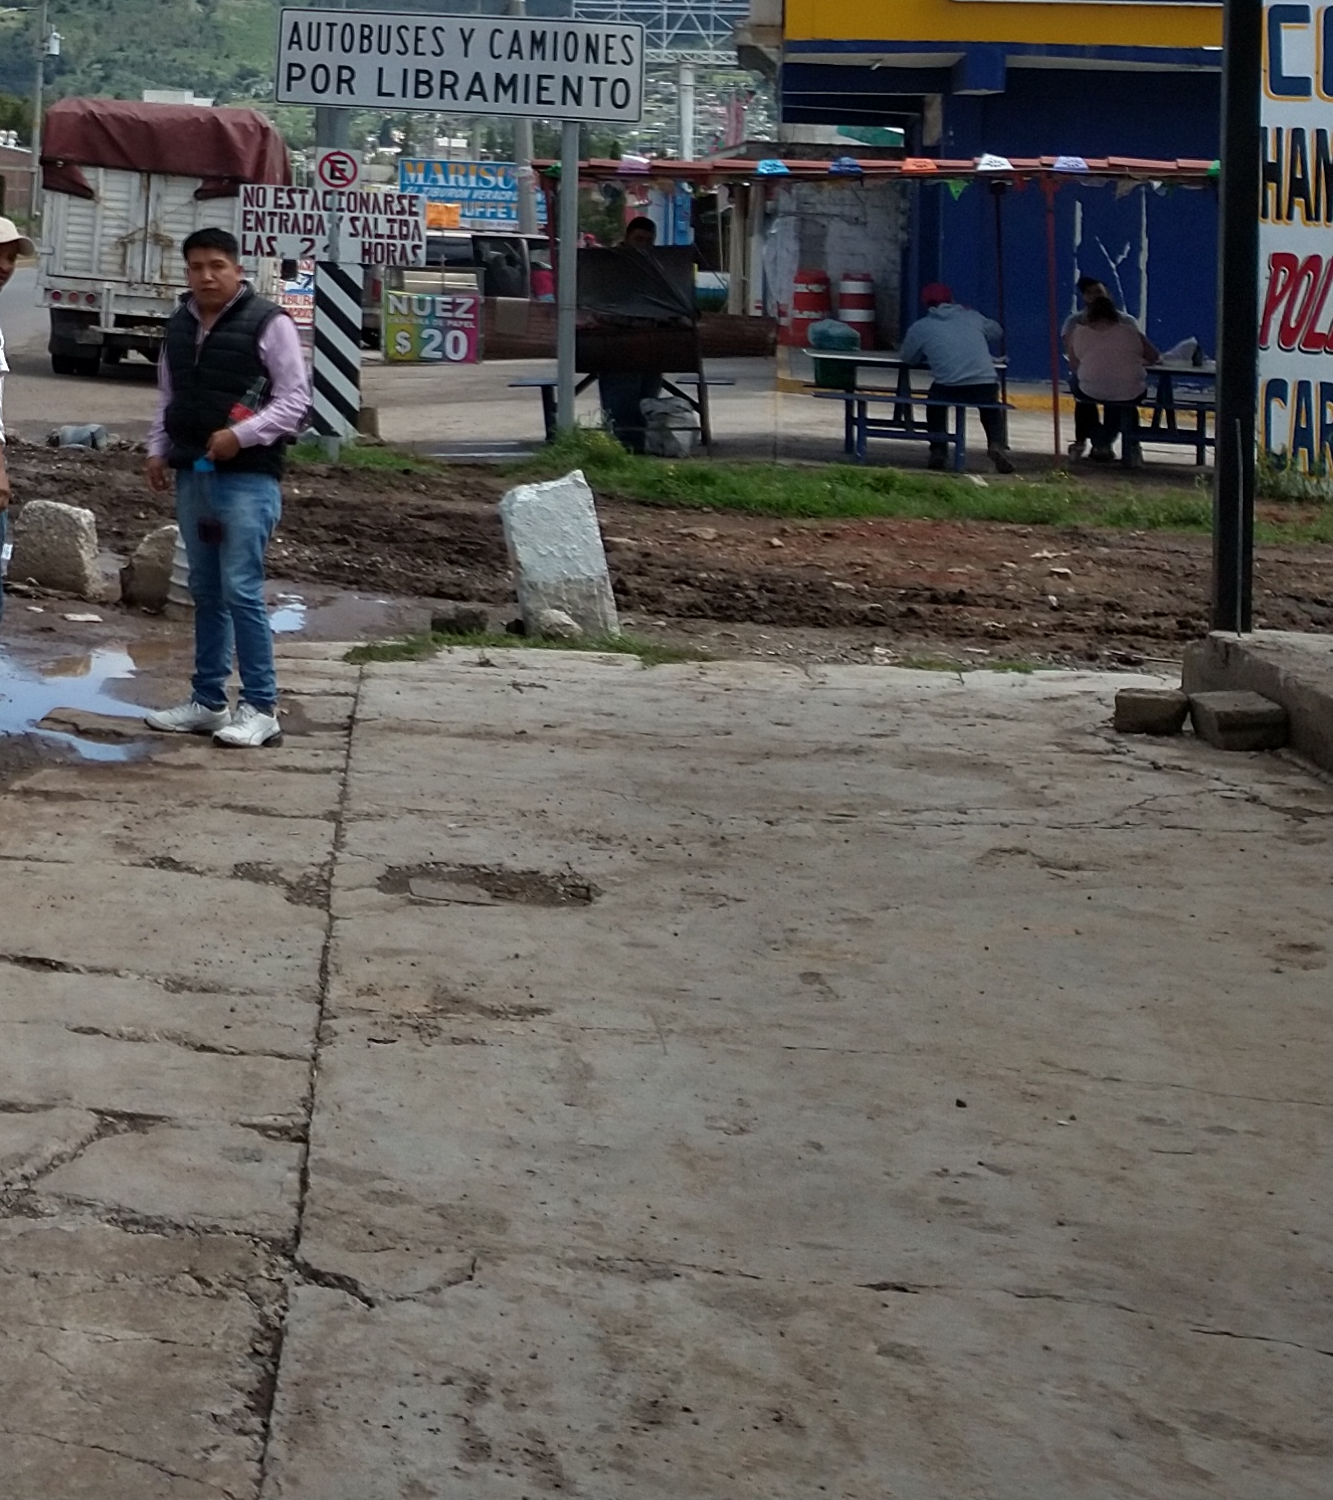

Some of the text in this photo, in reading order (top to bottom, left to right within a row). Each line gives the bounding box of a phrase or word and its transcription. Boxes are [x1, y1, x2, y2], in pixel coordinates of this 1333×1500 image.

[288, 21, 635, 66] AUTOBUSES Y CAMIONES
[286, 62, 631, 110] POR LIBRAMIENTO
[402, 161, 514, 190] MARISC
[243, 186, 420, 217] NO ESTACIONARSE
[242, 210, 326, 236] ENTRADA
[349, 216, 423, 243] SALIDA
[241, 234, 278, 257] LAS
[361, 241, 423, 266] HORAS
[388, 294, 475, 319] NUEZ
[1259, 252, 1333, 354] POL
[395, 328, 468, 362] $ 20
